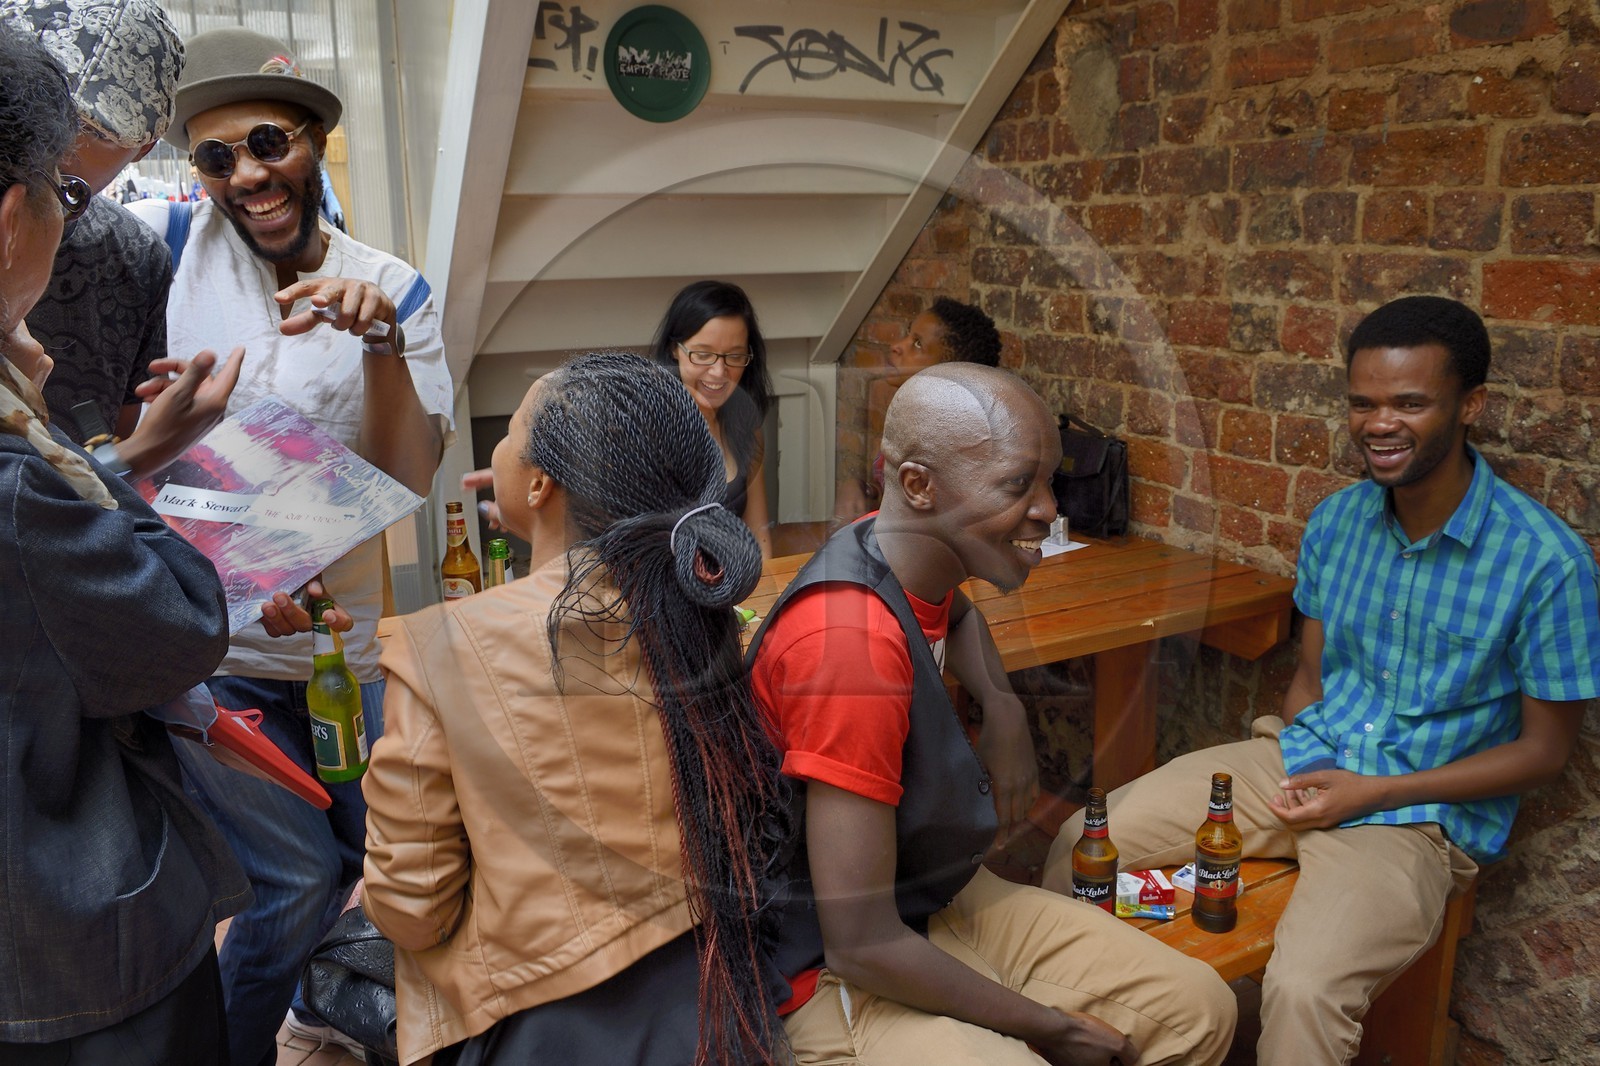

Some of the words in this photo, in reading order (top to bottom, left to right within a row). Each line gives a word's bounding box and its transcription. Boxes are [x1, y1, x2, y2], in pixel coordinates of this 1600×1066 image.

[659, 67, 691, 80] PLATE
[159, 494, 198, 508] Mark
[201, 500, 251, 513] Stewart
[1198, 868, 1222, 879] Black
[1086, 885, 1109, 897] Label
